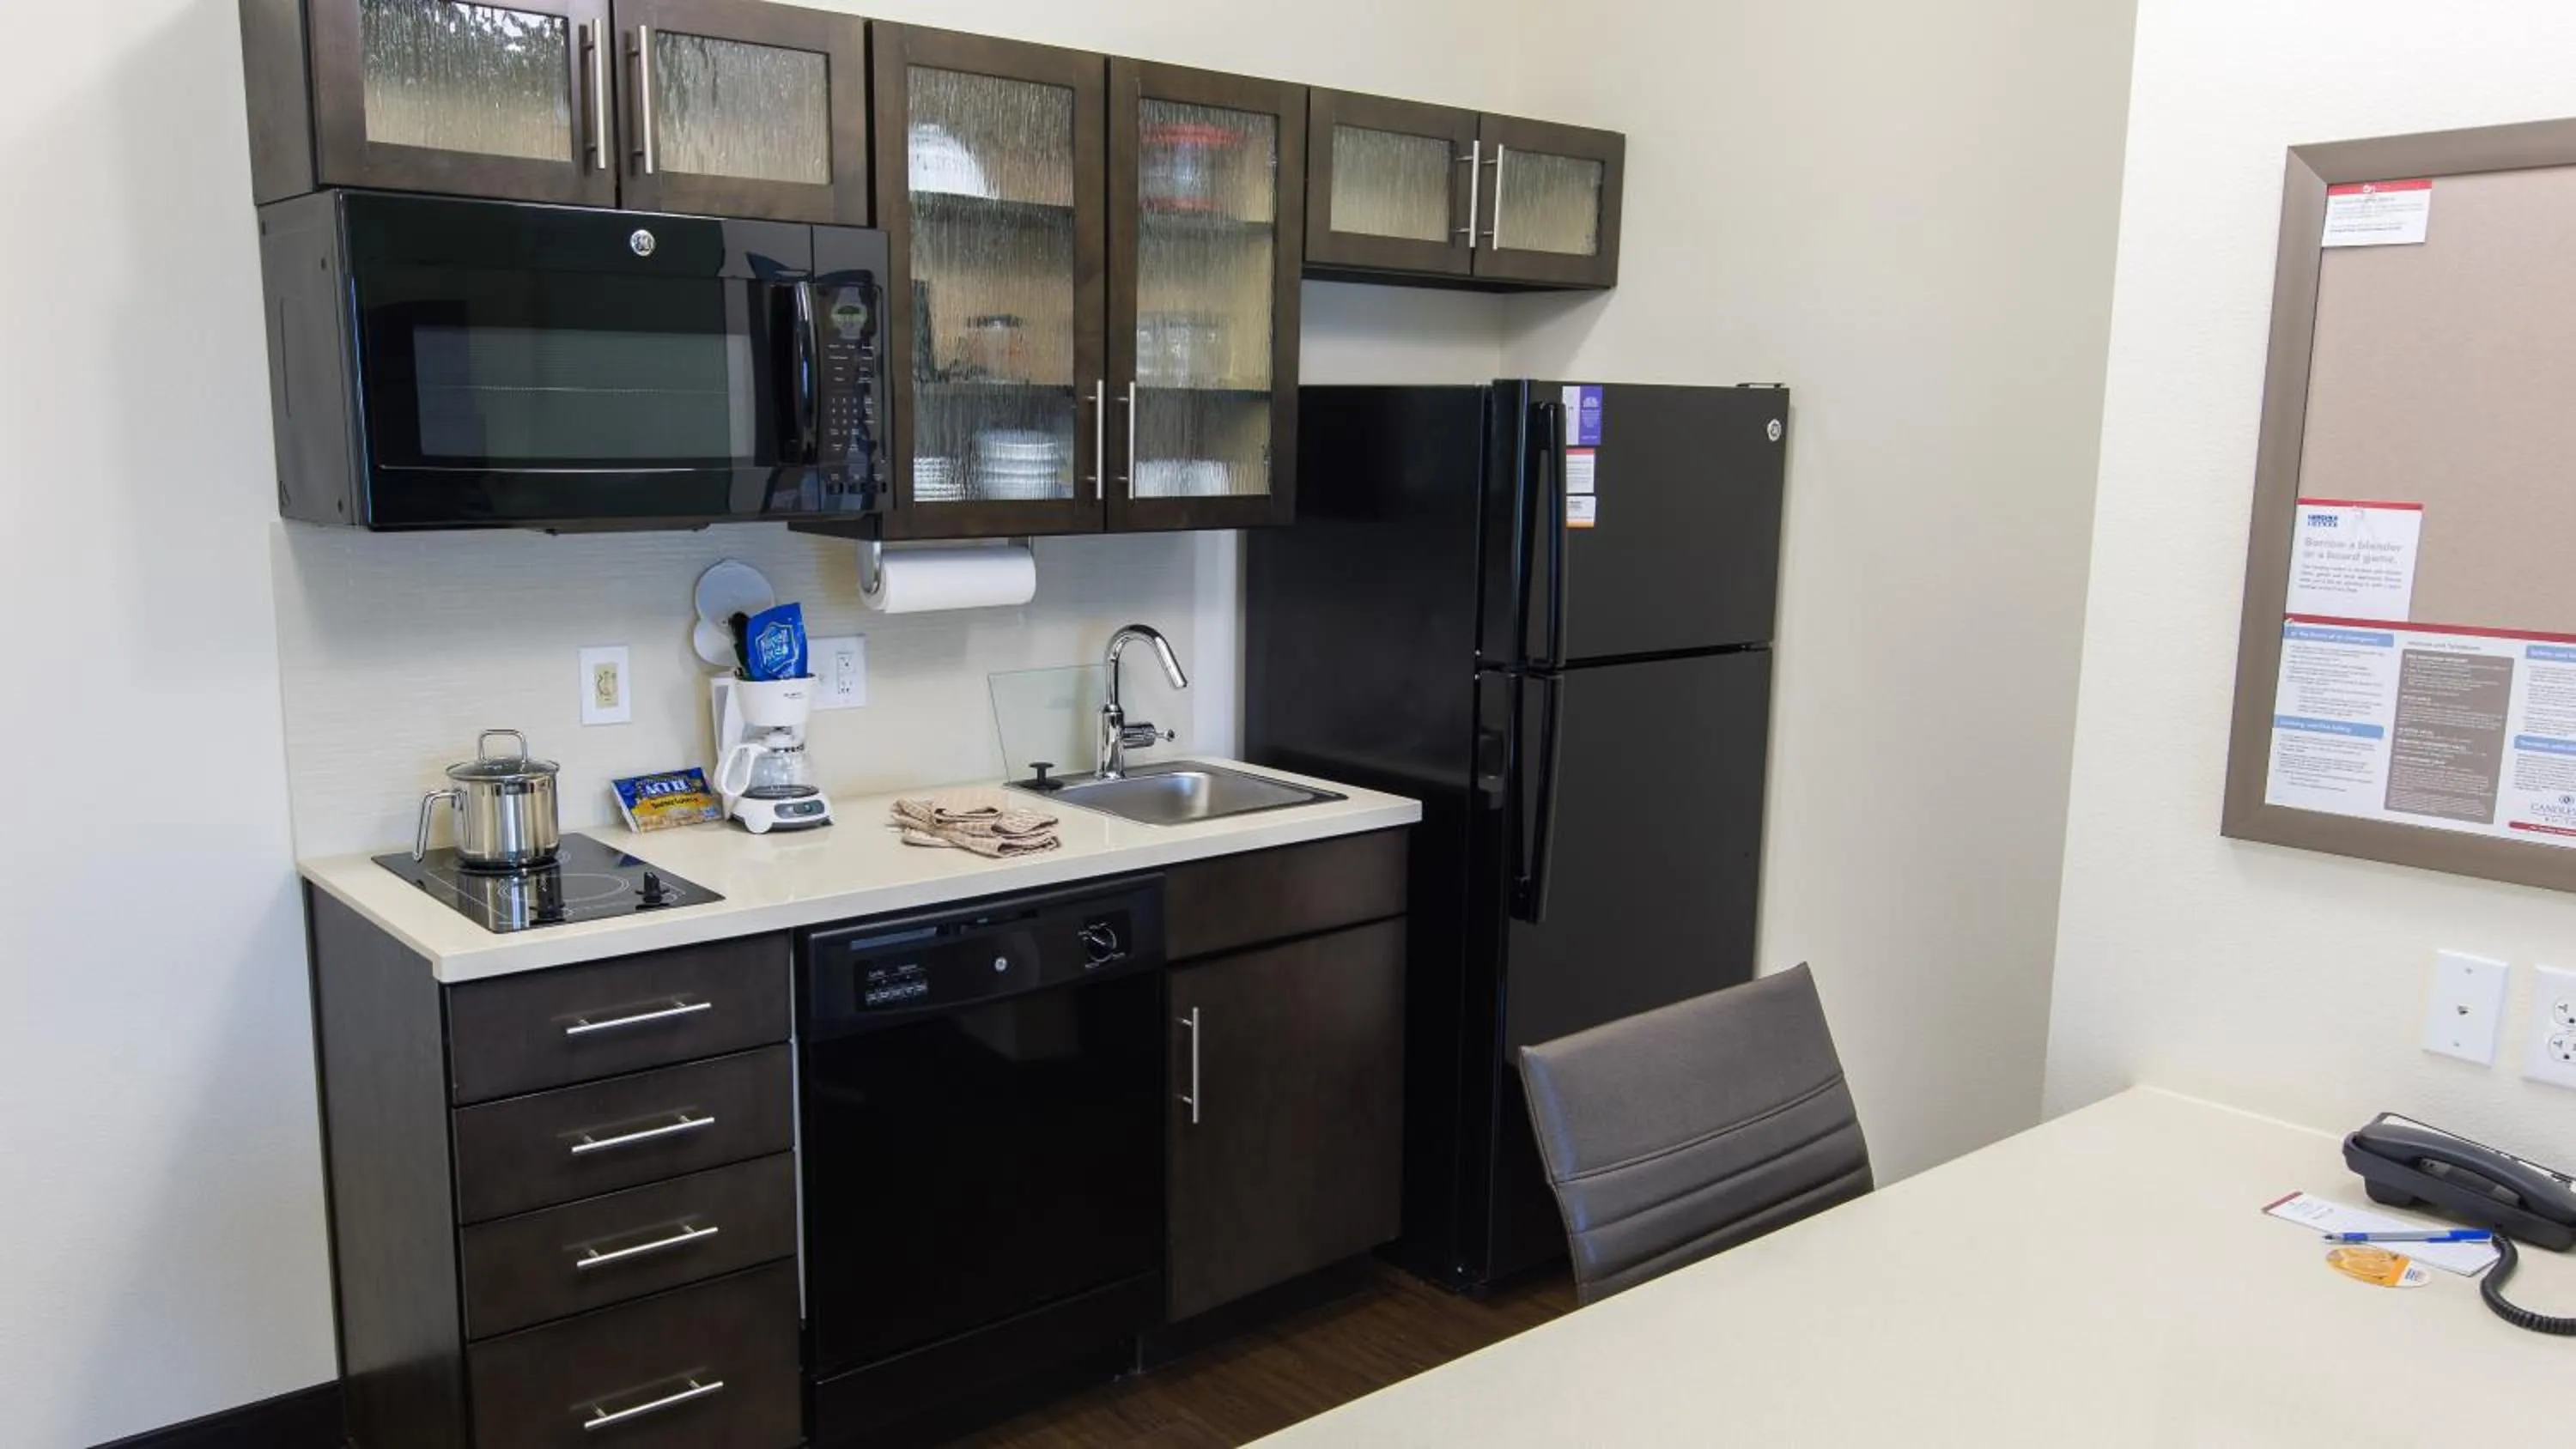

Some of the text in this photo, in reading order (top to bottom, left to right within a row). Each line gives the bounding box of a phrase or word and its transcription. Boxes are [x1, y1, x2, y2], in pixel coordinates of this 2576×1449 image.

[2305, 537, 2347, 549] Borrow
[2357, 539, 2403, 552] blender
[2326, 551, 2361, 562] board
